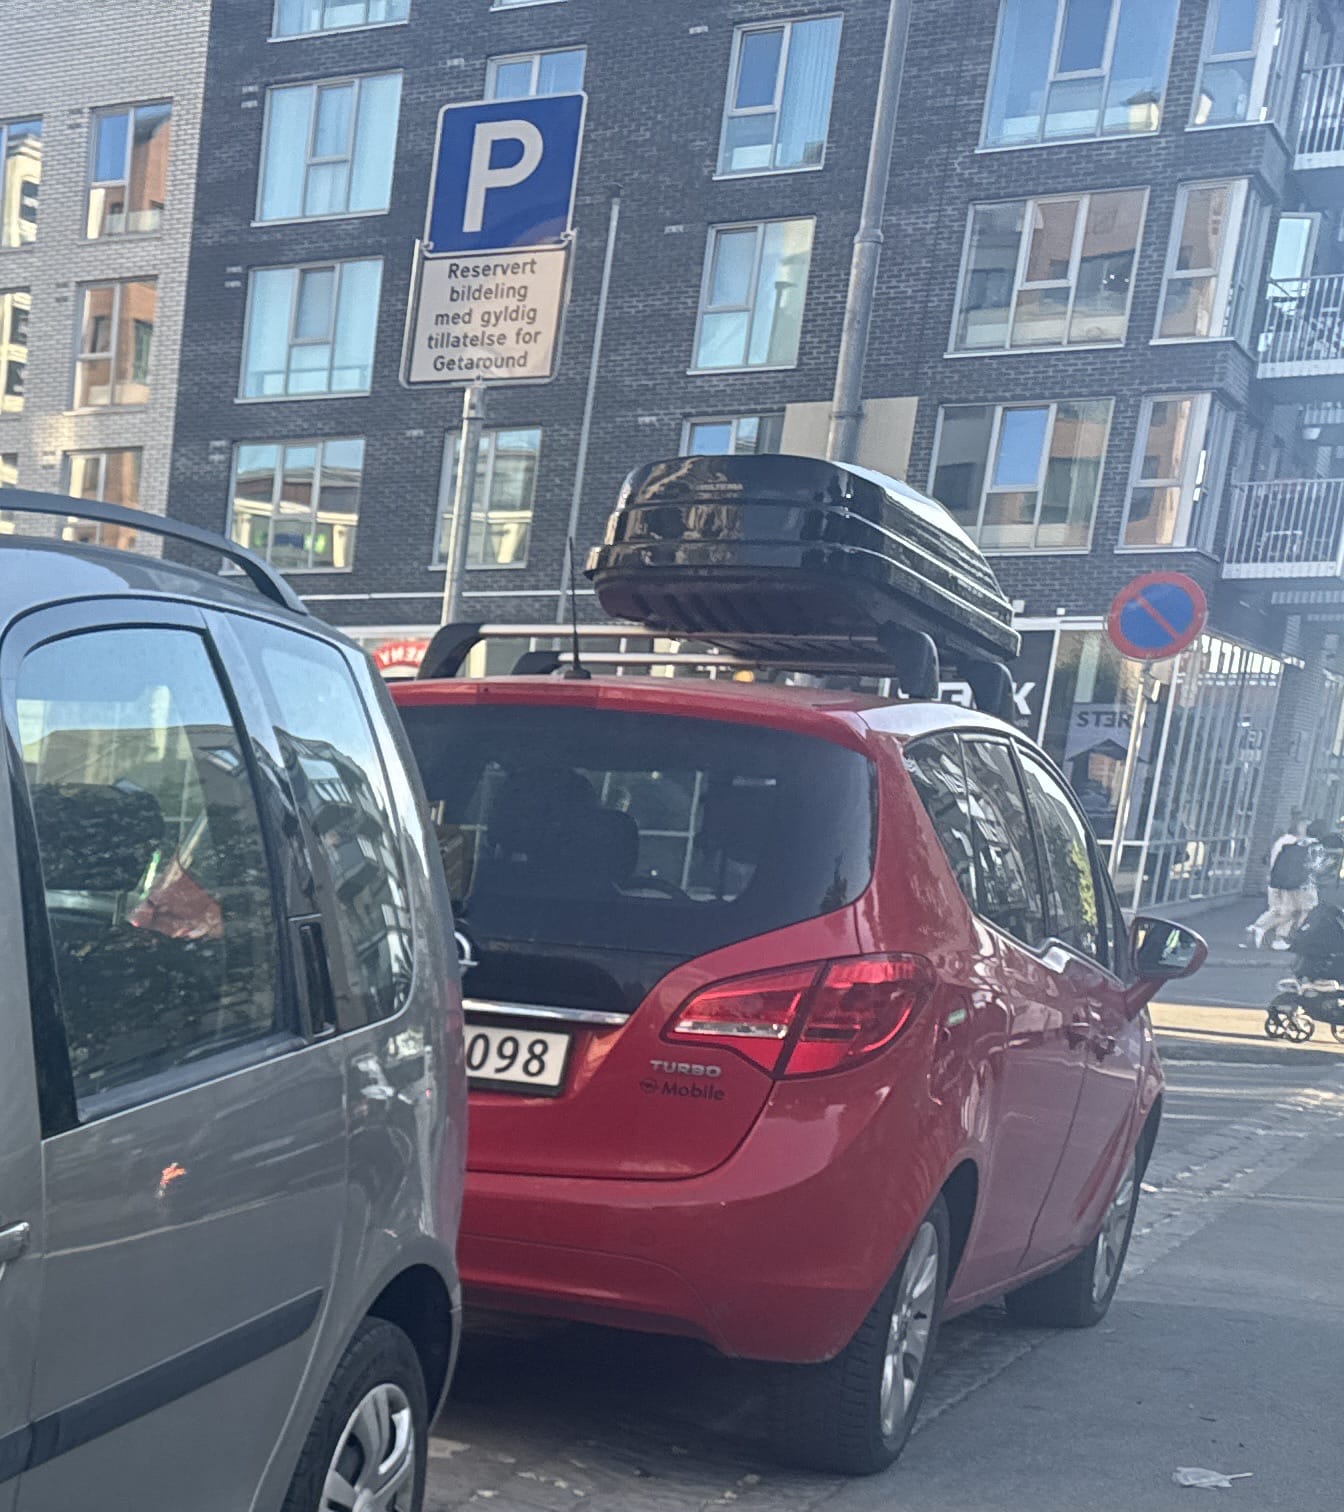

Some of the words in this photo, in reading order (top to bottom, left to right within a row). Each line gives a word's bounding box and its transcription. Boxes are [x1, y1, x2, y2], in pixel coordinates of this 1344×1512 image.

[462, 119, 544, 232] P
[448, 258, 537, 279] Reservert
[449, 283, 528, 302] bildeling
[434, 307, 473, 326] med
[480, 305, 538, 328] gyldig
[427, 330, 507, 349] tillatelse
[515, 328, 541, 345] for
[433, 350, 528, 372] Getaround
[466, 1033, 549, 1078] 098
[649, 1060, 722, 1078] TURBO
